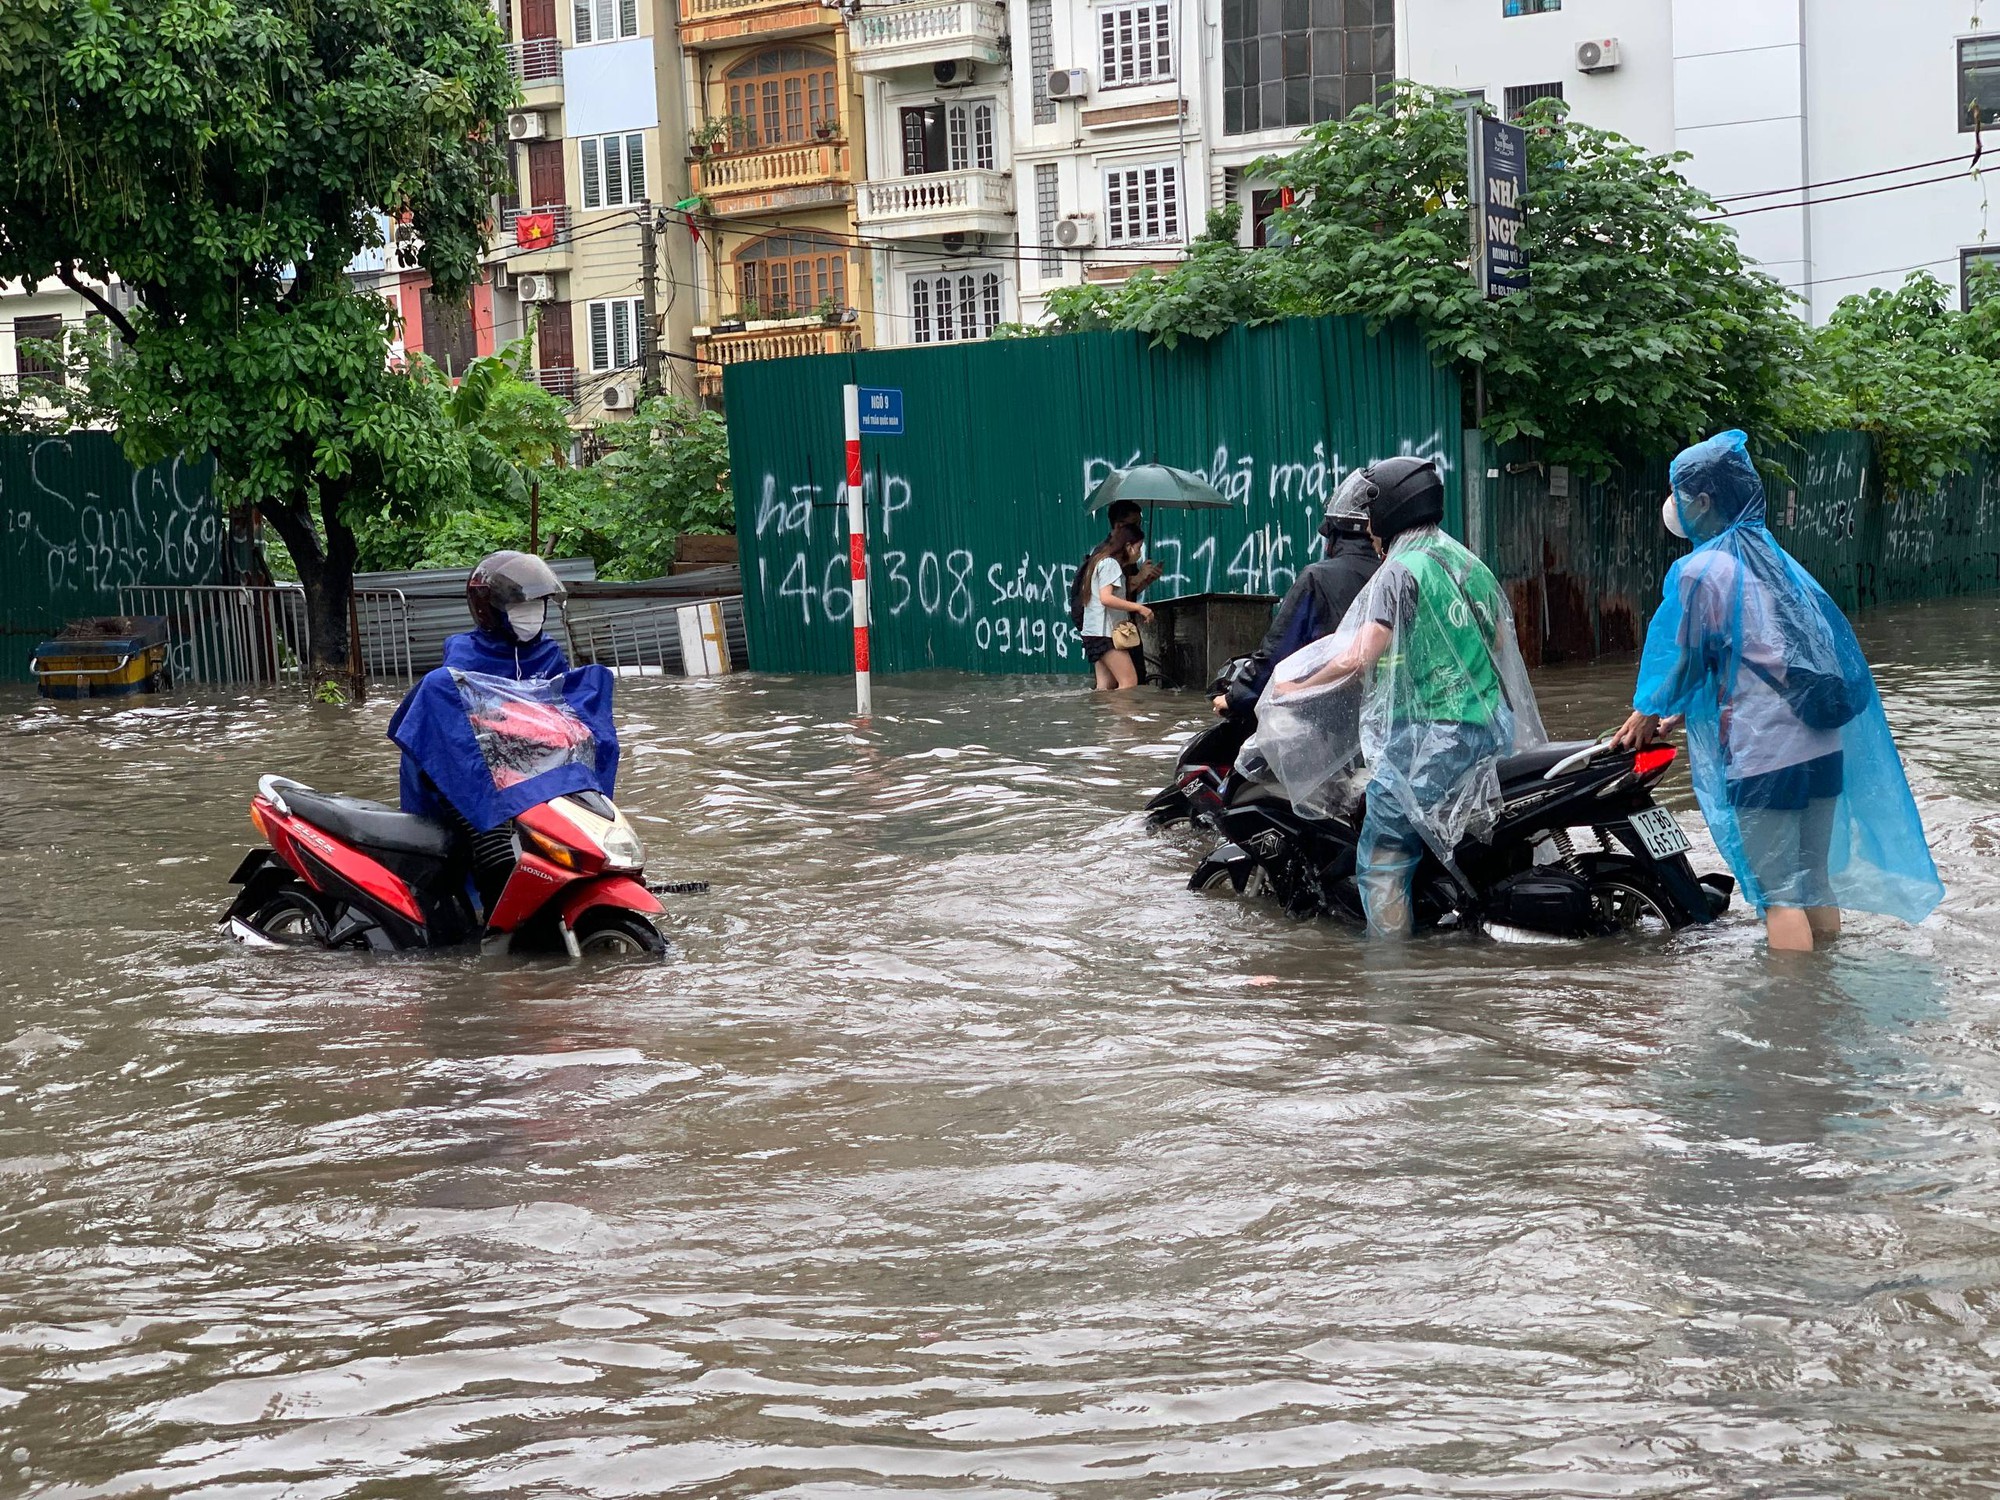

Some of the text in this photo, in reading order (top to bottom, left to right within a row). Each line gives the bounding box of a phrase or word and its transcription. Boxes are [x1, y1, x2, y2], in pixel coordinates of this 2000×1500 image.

[1519, 252, 1524, 264] 2
[884, 395, 889, 409] 9
[1637, 810, 1672, 834] 17-B6
[1647, 829, 1688, 855] 465.72
[520, 864, 554, 881] HONDA
